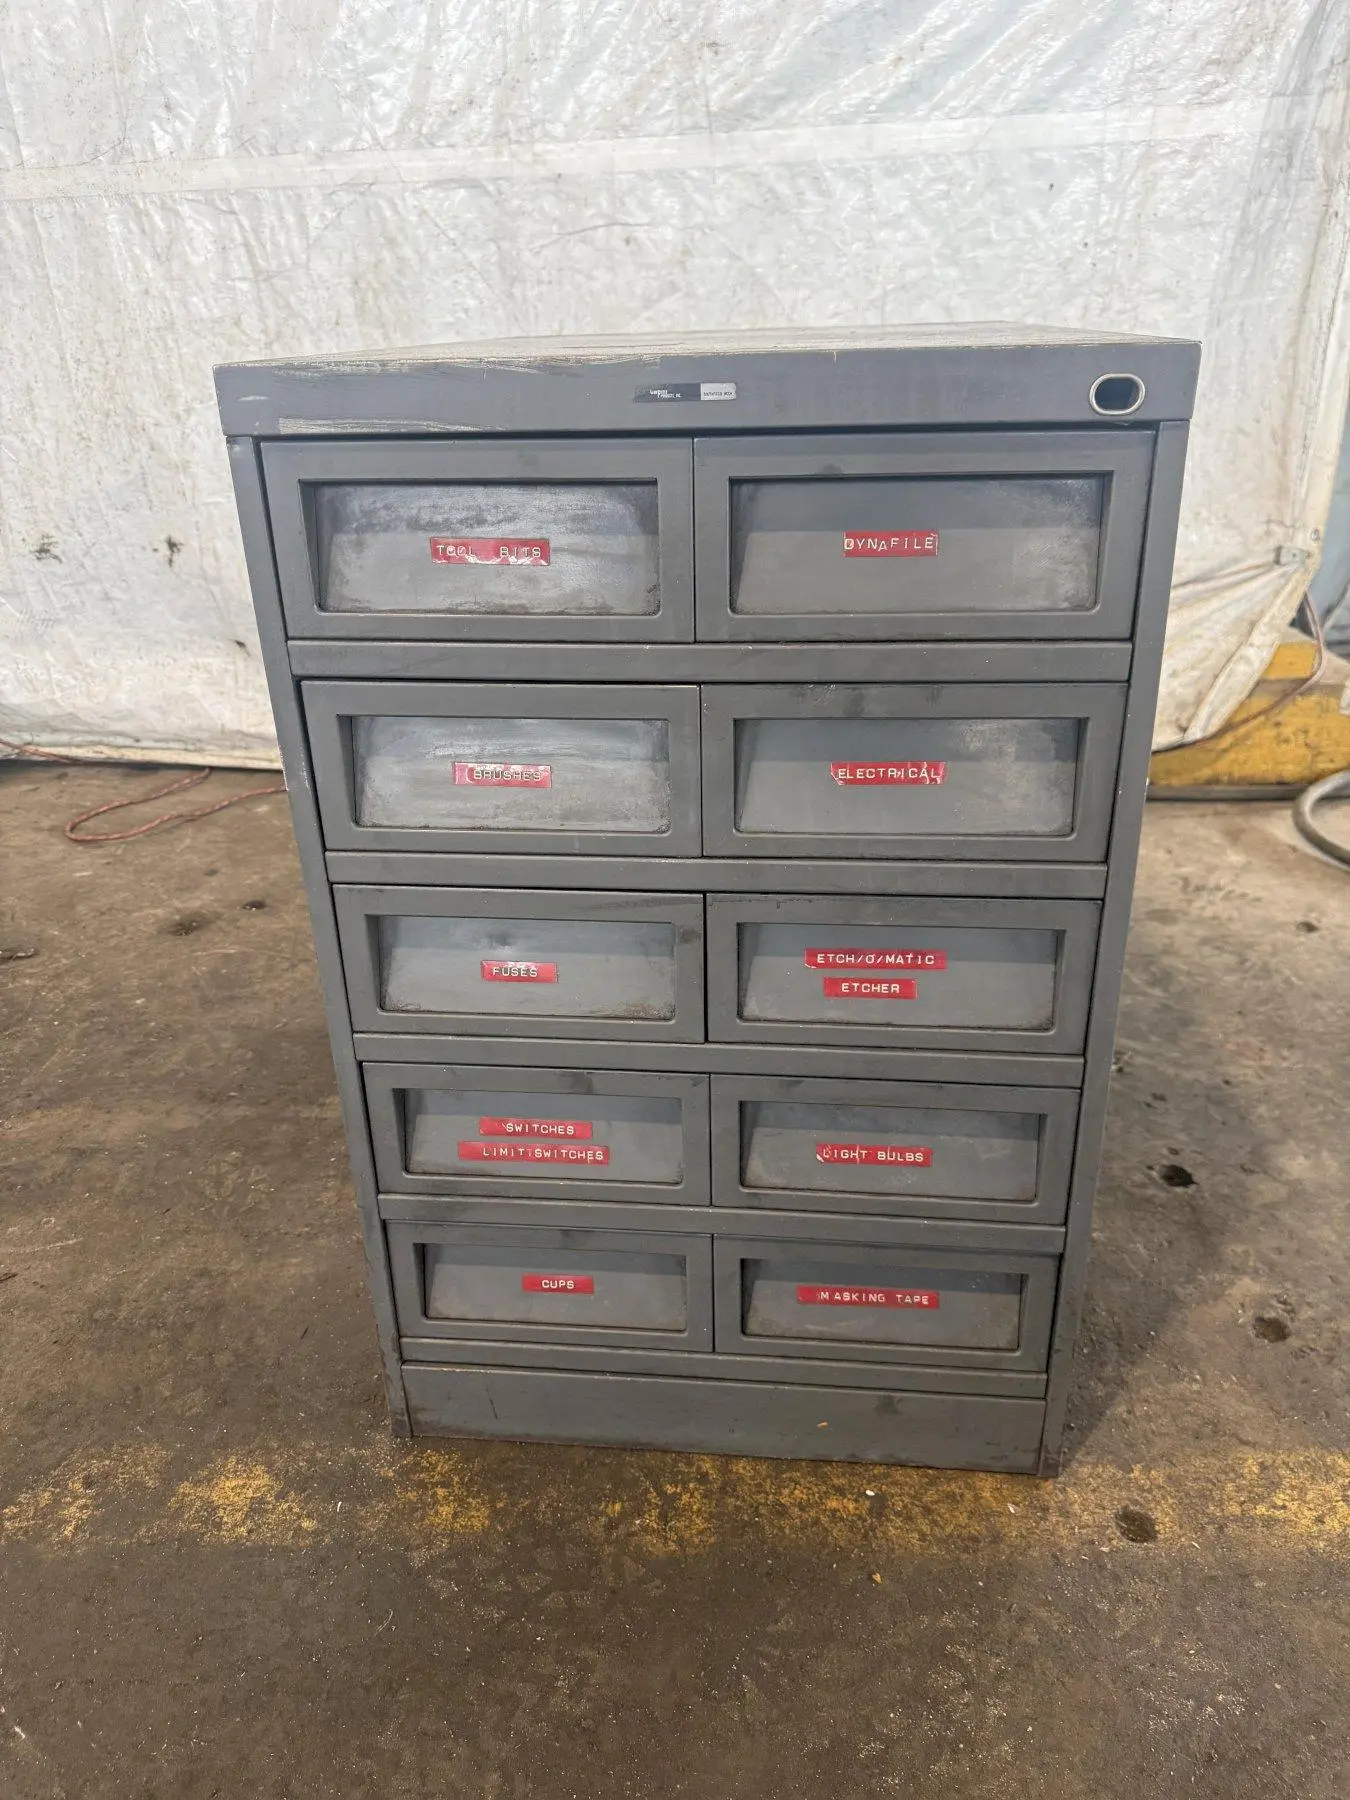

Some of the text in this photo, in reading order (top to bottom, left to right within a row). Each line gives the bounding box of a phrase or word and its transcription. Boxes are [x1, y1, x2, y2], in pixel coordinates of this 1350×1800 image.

[844, 537, 934, 551] DYNAFILE
[437, 545, 541, 558] TOOL BITS
[473, 769, 541, 782] BRUSHES
[838, 767, 941, 779] ELECTRICAL
[493, 967, 538, 978] FUSES
[841, 982, 900, 994] ETCHER
[506, 1123, 575, 1135] SWITCHES
[823, 1149, 924, 1162] LIGHT BULBS
[541, 1279, 575, 1289] CUPS
[820, 1291, 929, 1305] MASKING TAPE
